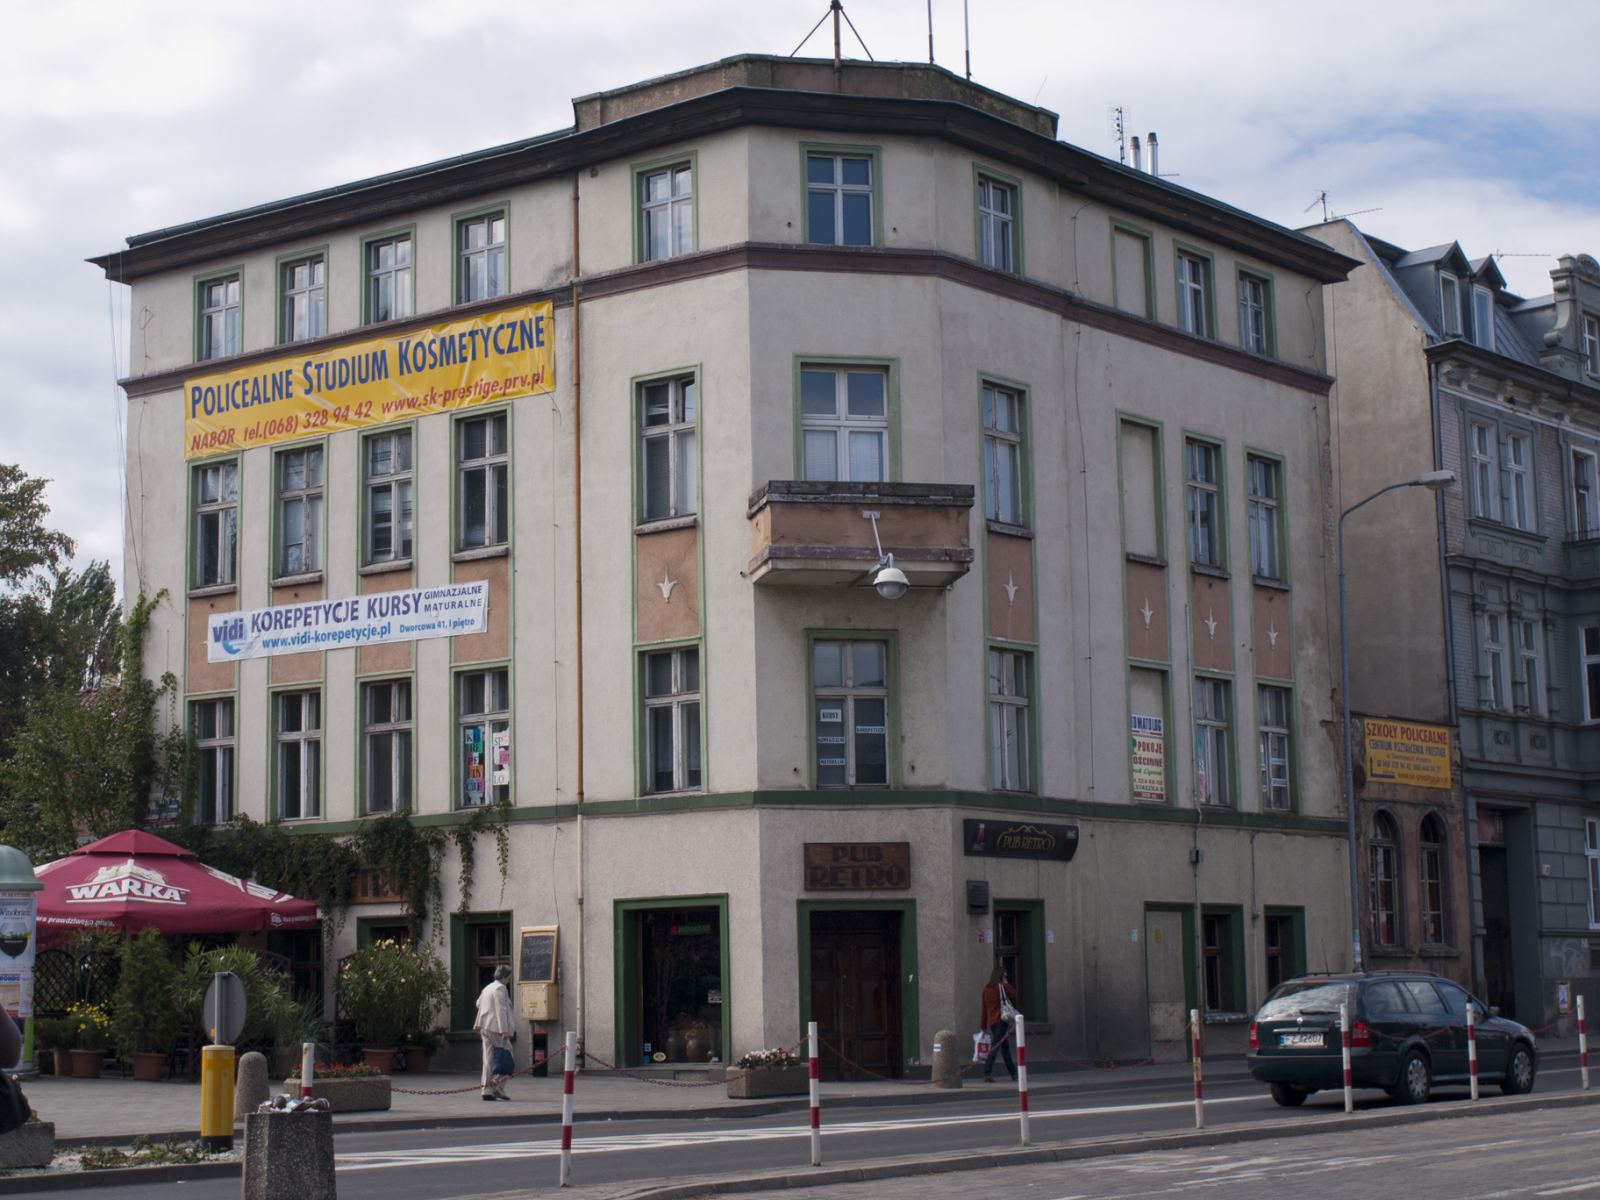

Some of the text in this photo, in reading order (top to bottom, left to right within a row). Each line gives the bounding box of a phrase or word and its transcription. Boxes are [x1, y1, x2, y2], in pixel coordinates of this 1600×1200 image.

[191, 315, 545, 419] POLICEALNE STUDIUM KOSMETYCZNE
[191, 427, 236, 451] NABÓR
[303, 408, 329, 430] 328
[333, 404, 351, 423] 94
[355, 401, 372, 418] 42
[381, 364, 545, 415] www.sk-prestige.prv.pl
[424, 585, 483, 600] GIMNAZJALNE
[251, 592, 423, 633] KOREPETYCJE KURSY
[424, 598, 483, 612] MATURALNE
[212, 618, 244, 643] vidi
[262, 622, 391, 649] www.vidi-korepetycje.pl
[399, 622, 436, 634] Dworcowa
[1367, 723, 1447, 745] SZKOŁY POLICEALNE
[1138, 741, 1163, 754] POKOJE
[1133, 755, 1163, 768] OŚCINNE
[832, 846, 884, 863] PUB
[808, 864, 906, 888] RETRO
[70, 878, 182, 901] WARKA
[48, 917, 94, 926] prawdziwego
